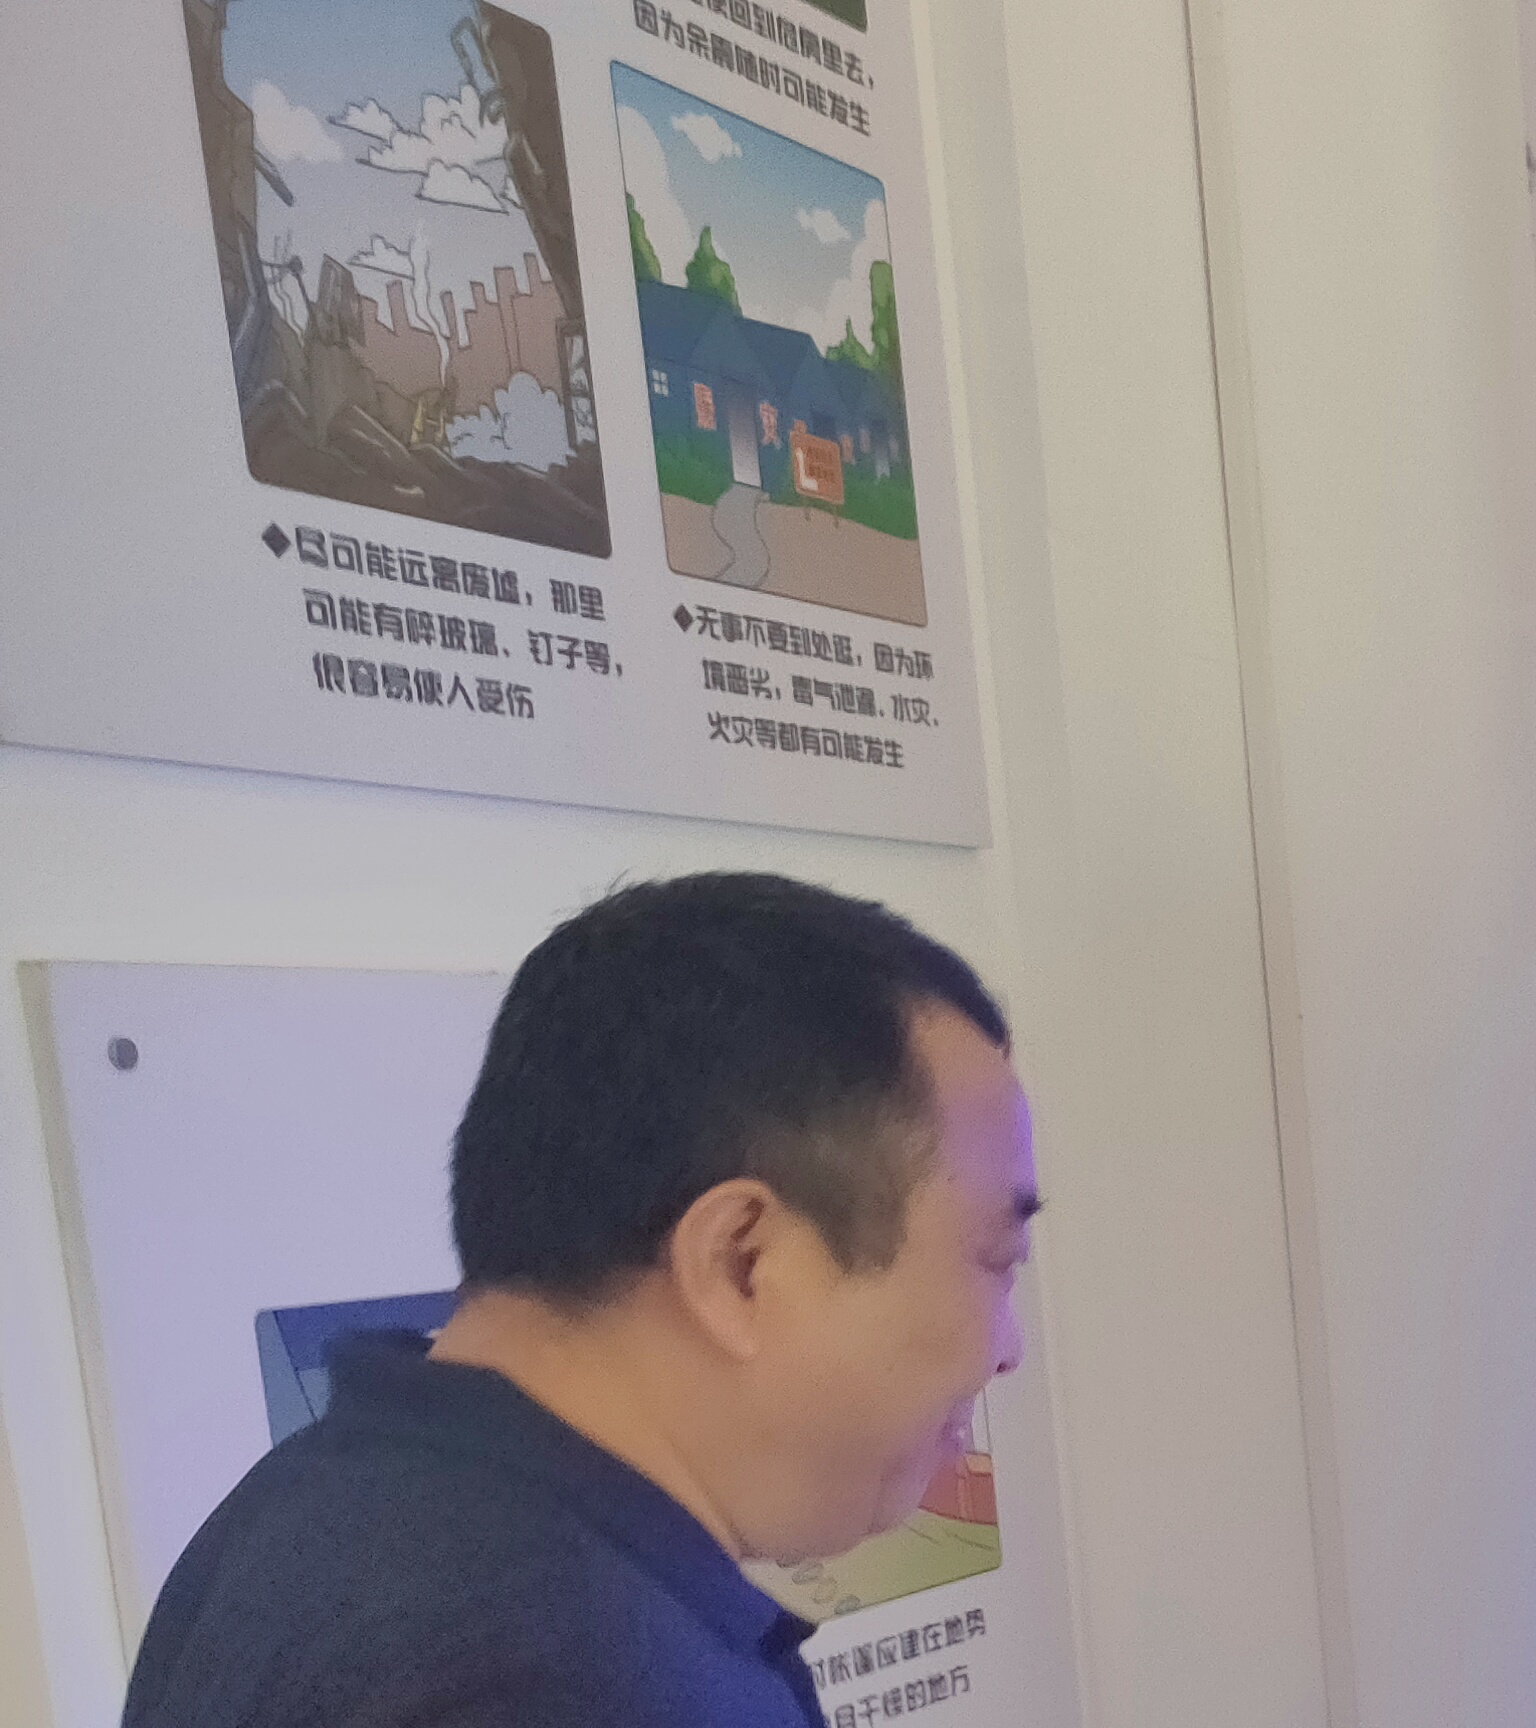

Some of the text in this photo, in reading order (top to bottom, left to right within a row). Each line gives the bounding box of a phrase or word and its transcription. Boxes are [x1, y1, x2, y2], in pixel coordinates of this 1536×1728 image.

[312, 652, 535, 719] 很容易使人受伤
[707, 711, 904, 768] 火灾等都有可能发生
